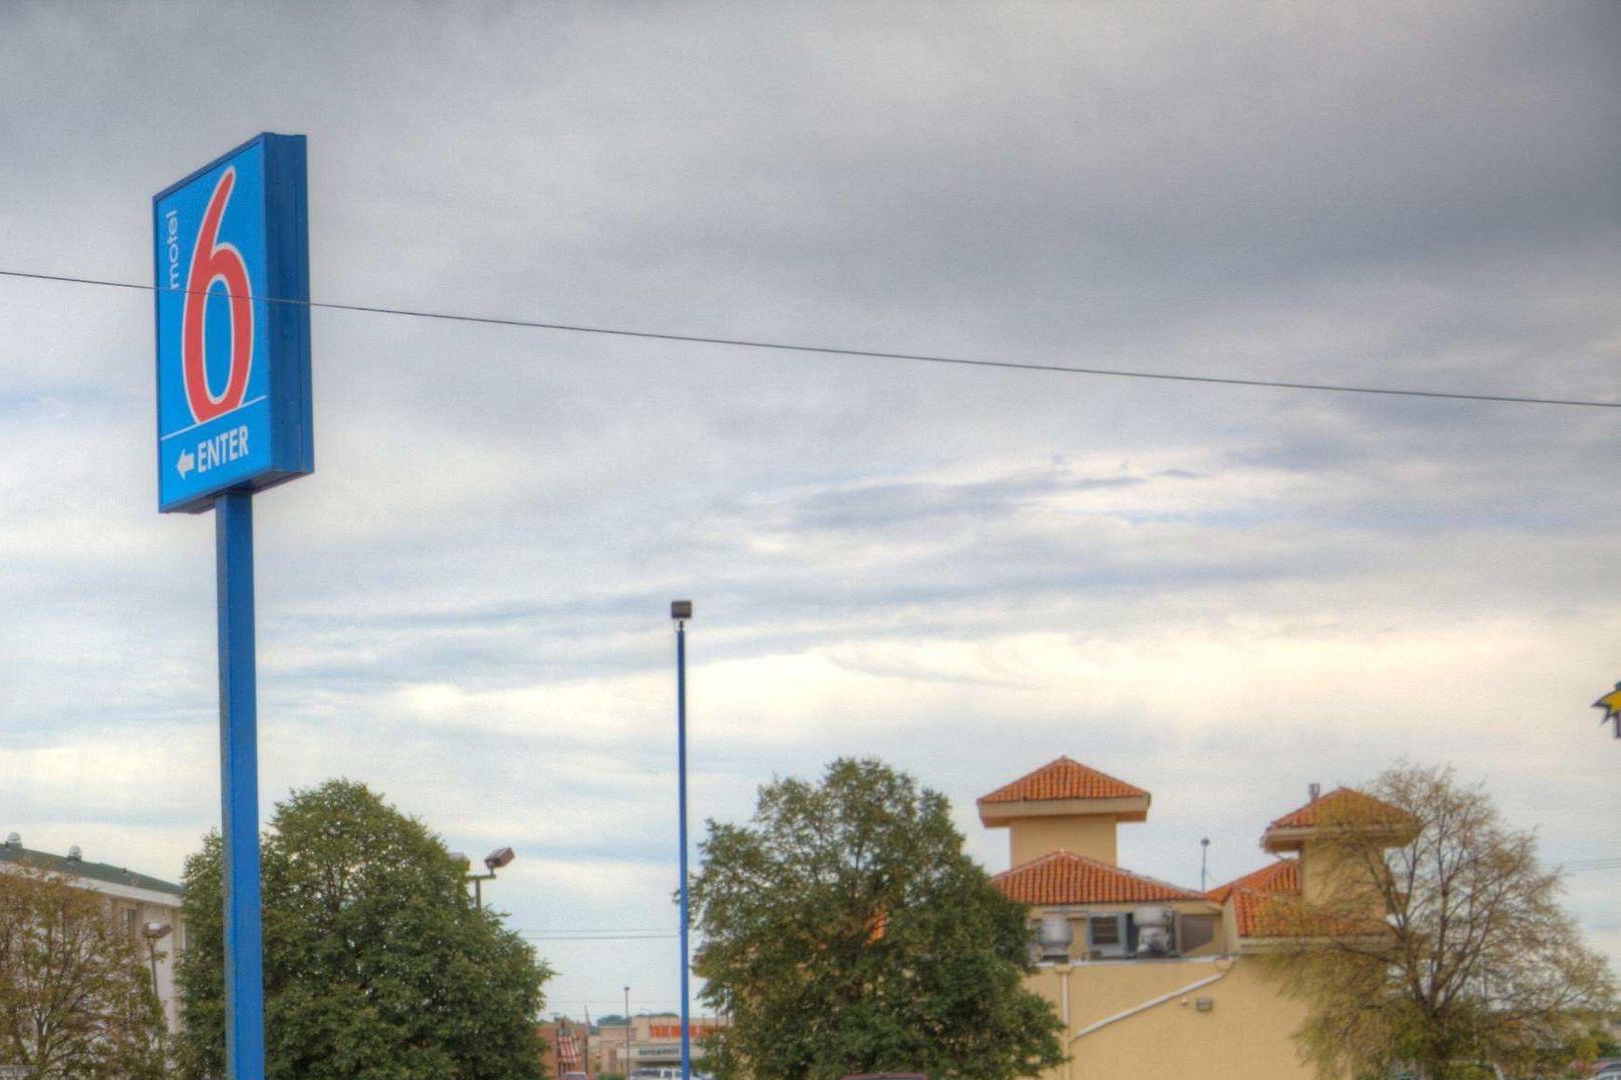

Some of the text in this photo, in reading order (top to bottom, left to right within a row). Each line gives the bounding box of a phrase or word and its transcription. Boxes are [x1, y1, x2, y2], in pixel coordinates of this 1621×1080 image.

[165, 209, 180, 290] motel
[182, 166, 254, 423] 6
[197, 426, 249, 473] ENTER
